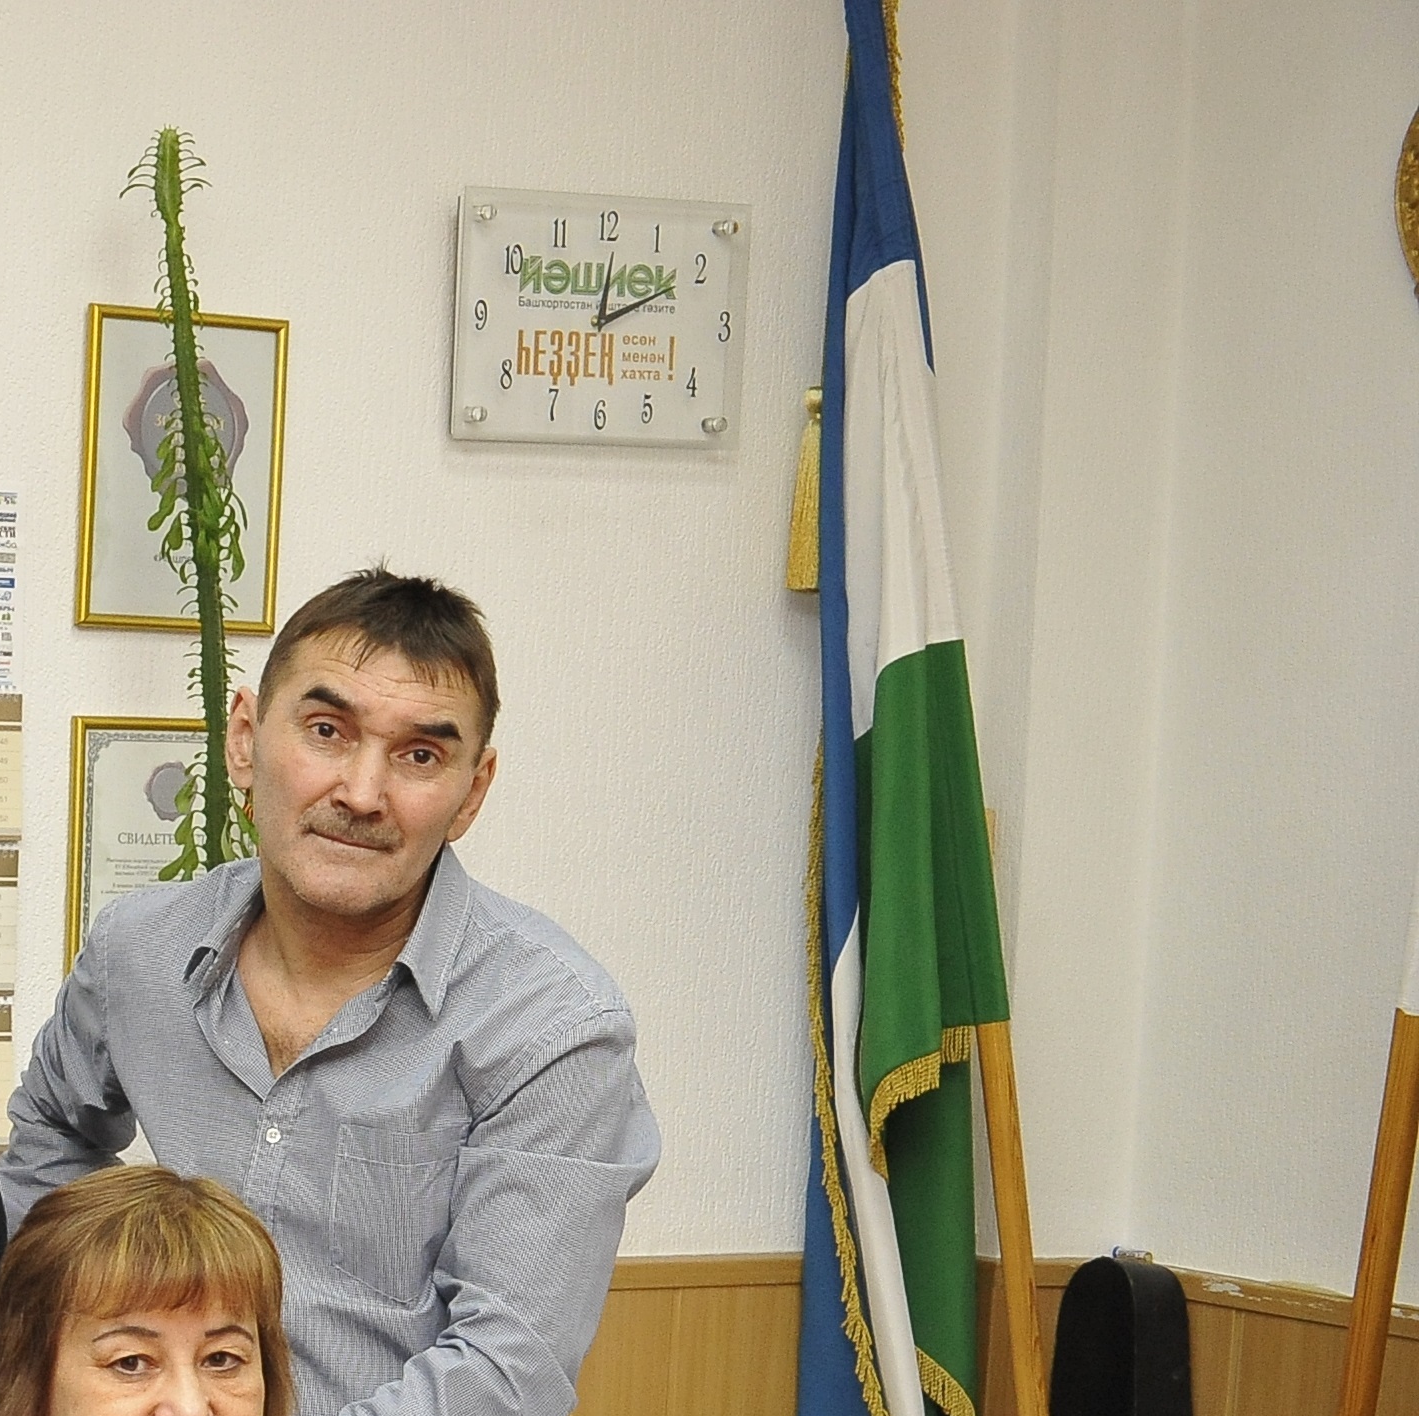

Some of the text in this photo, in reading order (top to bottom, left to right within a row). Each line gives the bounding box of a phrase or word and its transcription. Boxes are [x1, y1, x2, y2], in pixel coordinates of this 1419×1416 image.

[553, 218, 567, 249] 11
[599, 210, 619, 242] 12
[654, 224, 661, 253] 1
[504, 244, 524, 275] 10
[694, 254, 707, 284] 2
[474, 299, 488, 330] 9
[718, 311, 731, 342] 3
[622, 334, 657, 346] өсөн
[622, 352, 665, 364] менән
[500, 359, 513, 390] 8
[685, 367, 697, 397] 4
[548, 388, 559, 421] 7
[593, 400, 606, 430] 6
[641, 393, 653, 424] 5
